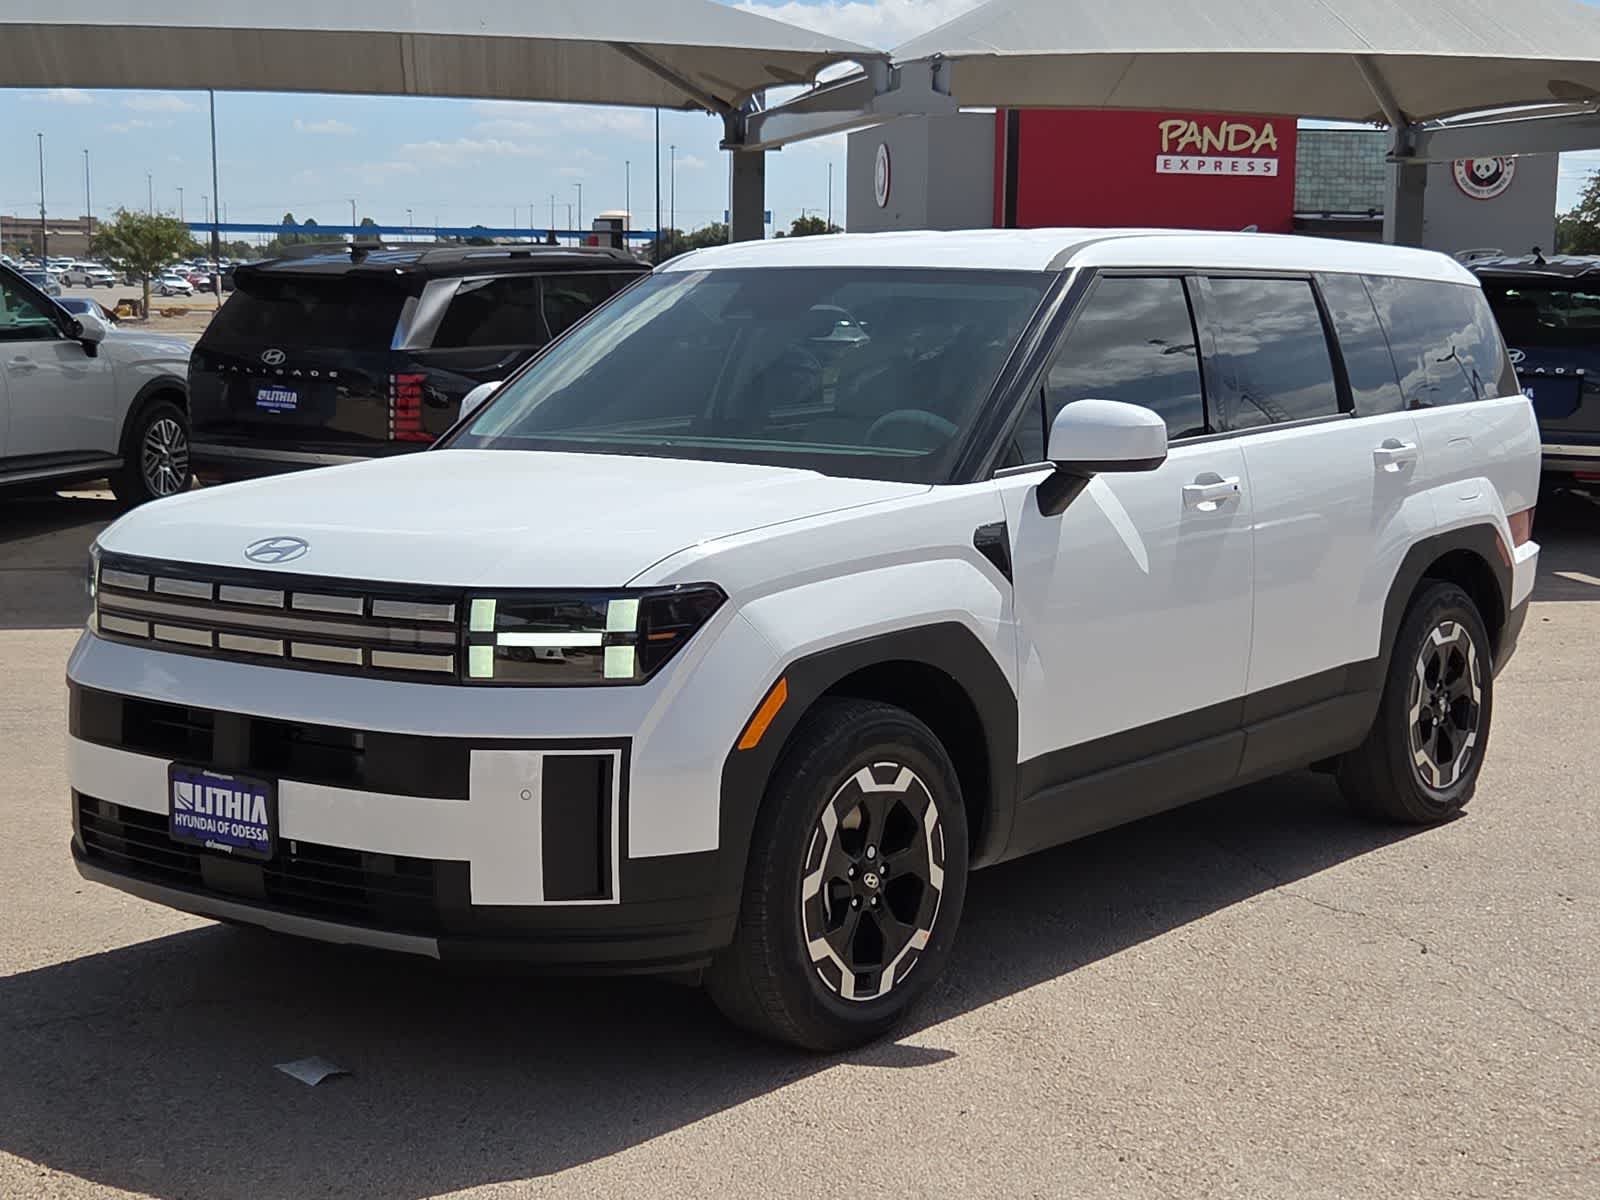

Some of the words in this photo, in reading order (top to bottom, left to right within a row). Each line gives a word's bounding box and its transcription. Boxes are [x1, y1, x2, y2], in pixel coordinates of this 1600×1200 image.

[1158, 119, 1278, 154] PANDA
[1162, 159, 1272, 173] EXPRESS
[266, 390, 298, 403] LITHIA
[194, 784, 269, 826] LITHIA
[174, 812, 217, 833] HYUNDAI
[217, 821, 231, 835] OF
[231, 823, 270, 843] ODESSA
